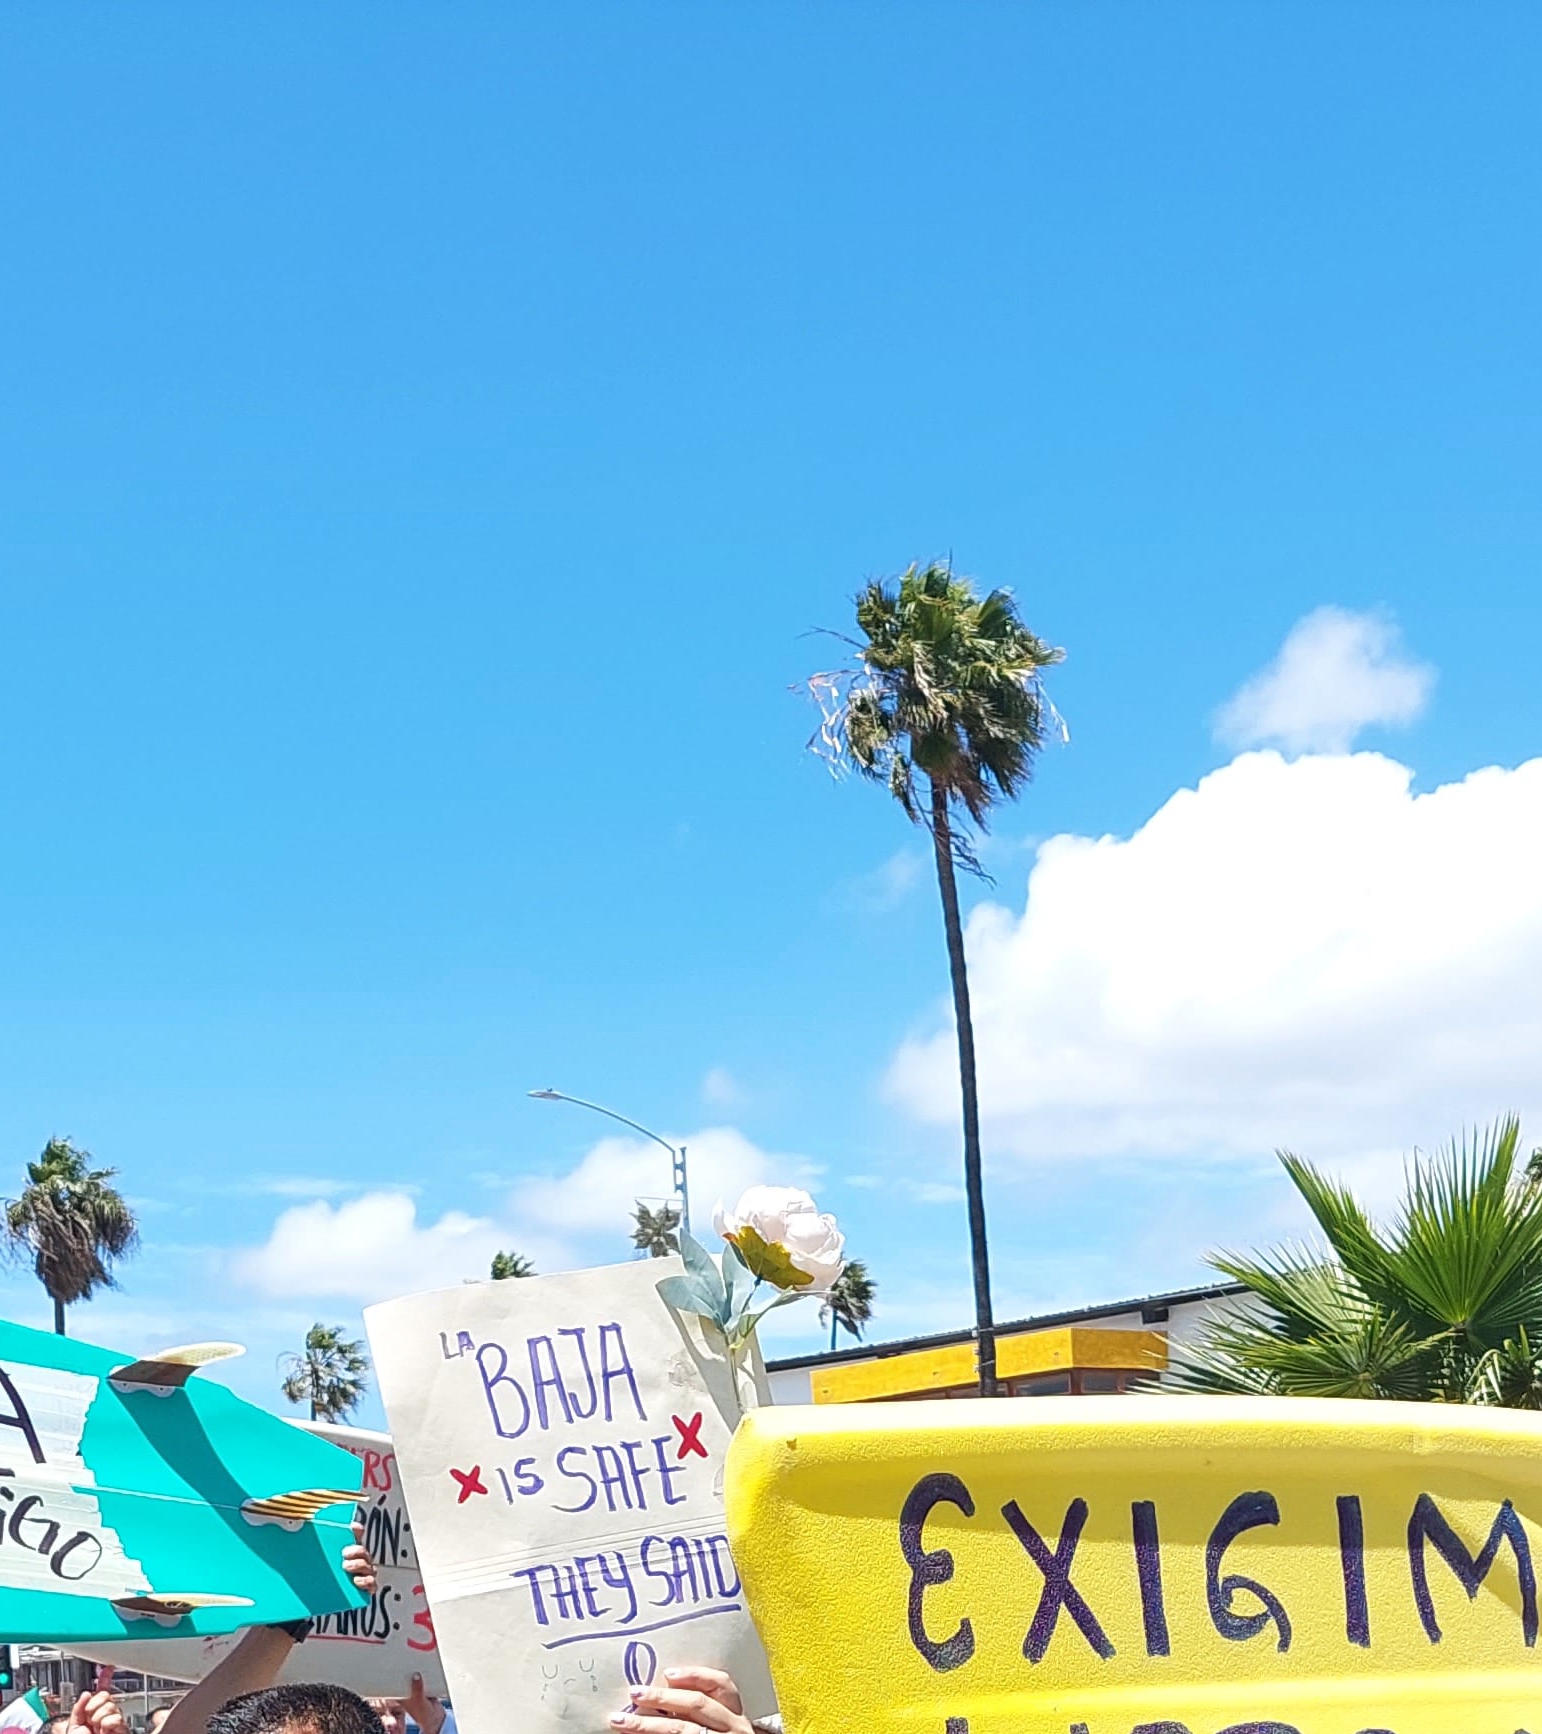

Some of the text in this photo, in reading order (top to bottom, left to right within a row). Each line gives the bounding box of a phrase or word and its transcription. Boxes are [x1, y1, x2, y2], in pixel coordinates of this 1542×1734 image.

[440, 1330, 476, 1360] LA
[476, 1322, 648, 1439] BAJA
[495, 1435, 687, 1513] IS SAFE
[639, 1535, 742, 1607] SAID
